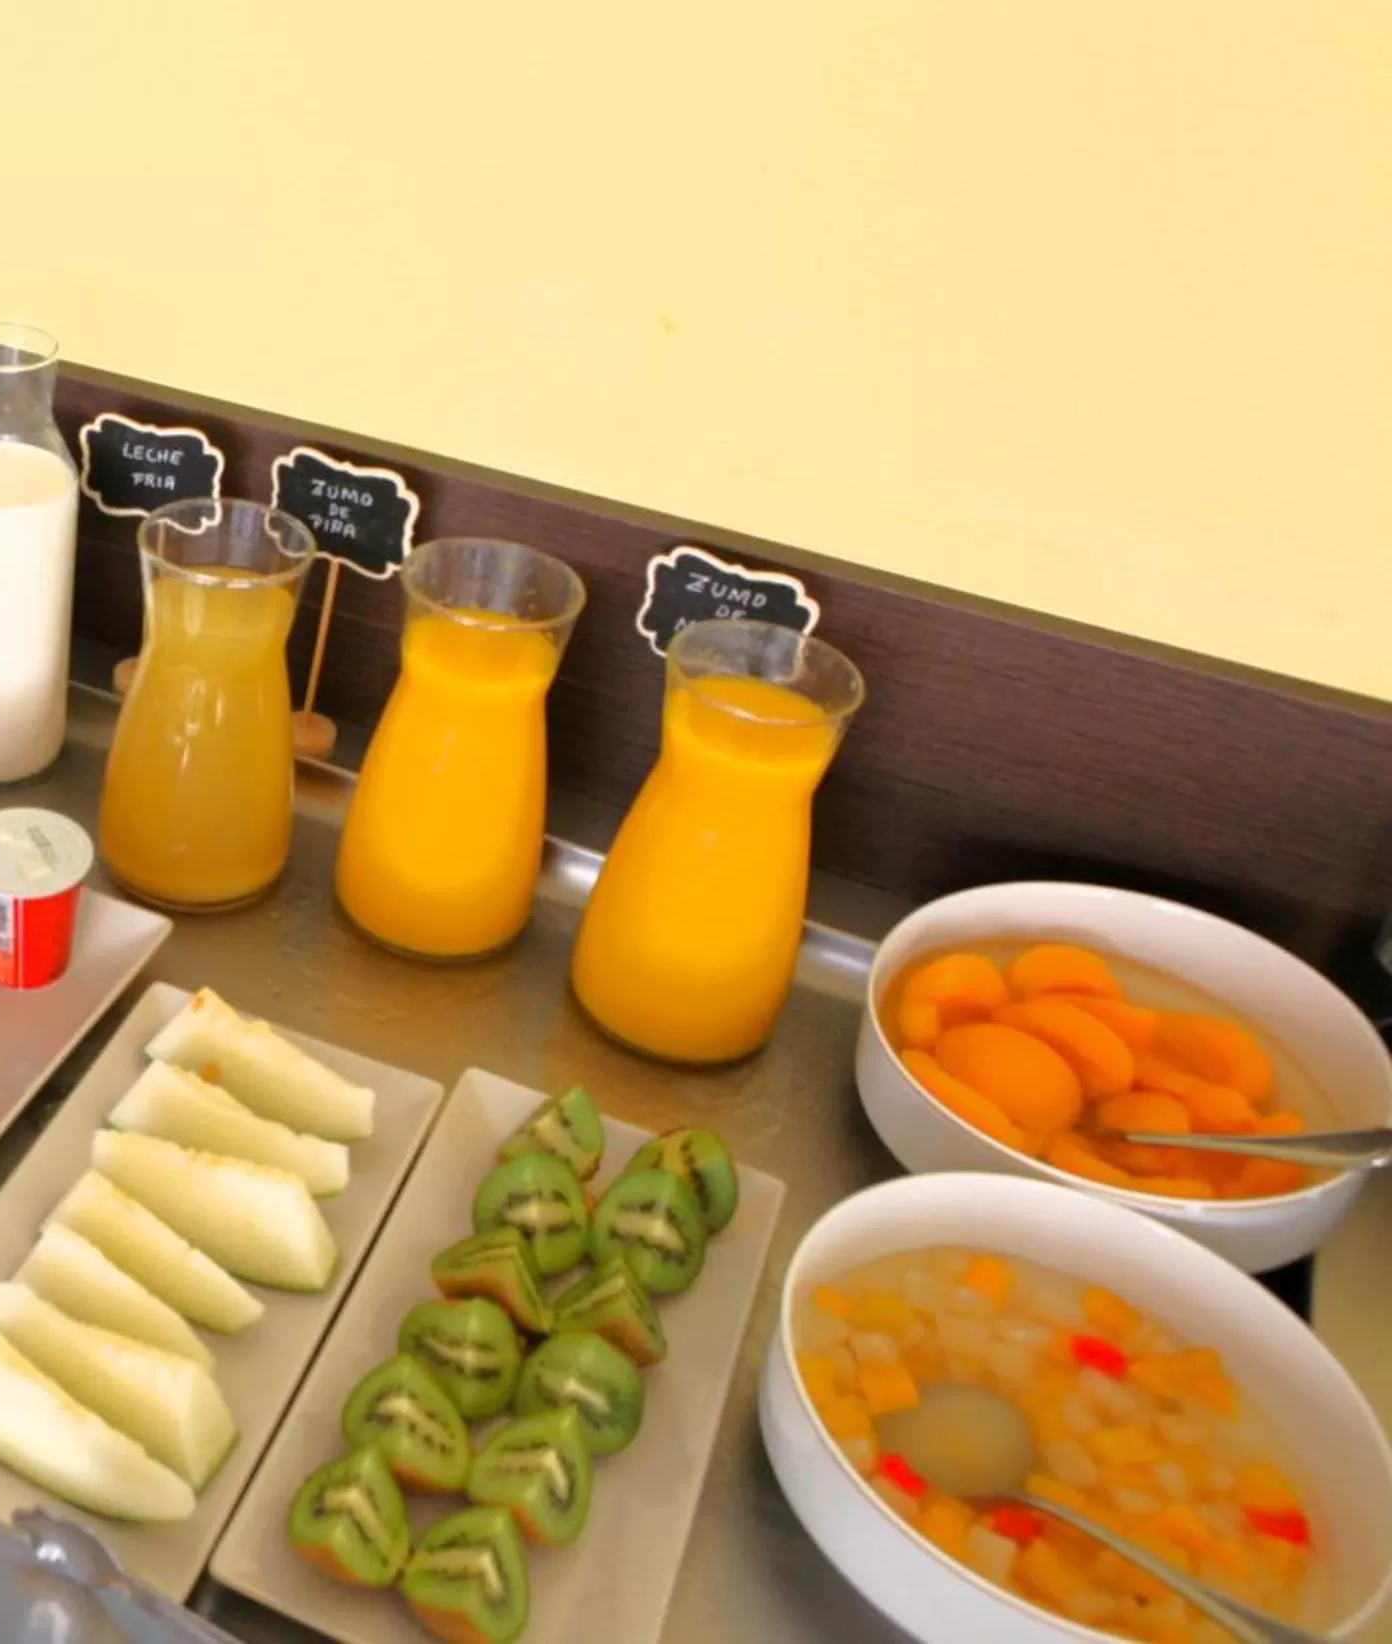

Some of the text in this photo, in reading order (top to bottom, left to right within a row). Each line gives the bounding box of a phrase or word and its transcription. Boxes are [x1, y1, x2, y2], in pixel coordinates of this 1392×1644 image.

[122, 440, 185, 466] LECHE
[310, 478, 373, 507] ZUMO
[329, 503, 350, 519] DE
[686, 572, 768, 608] ZUMO
[715, 604, 747, 622] DE
